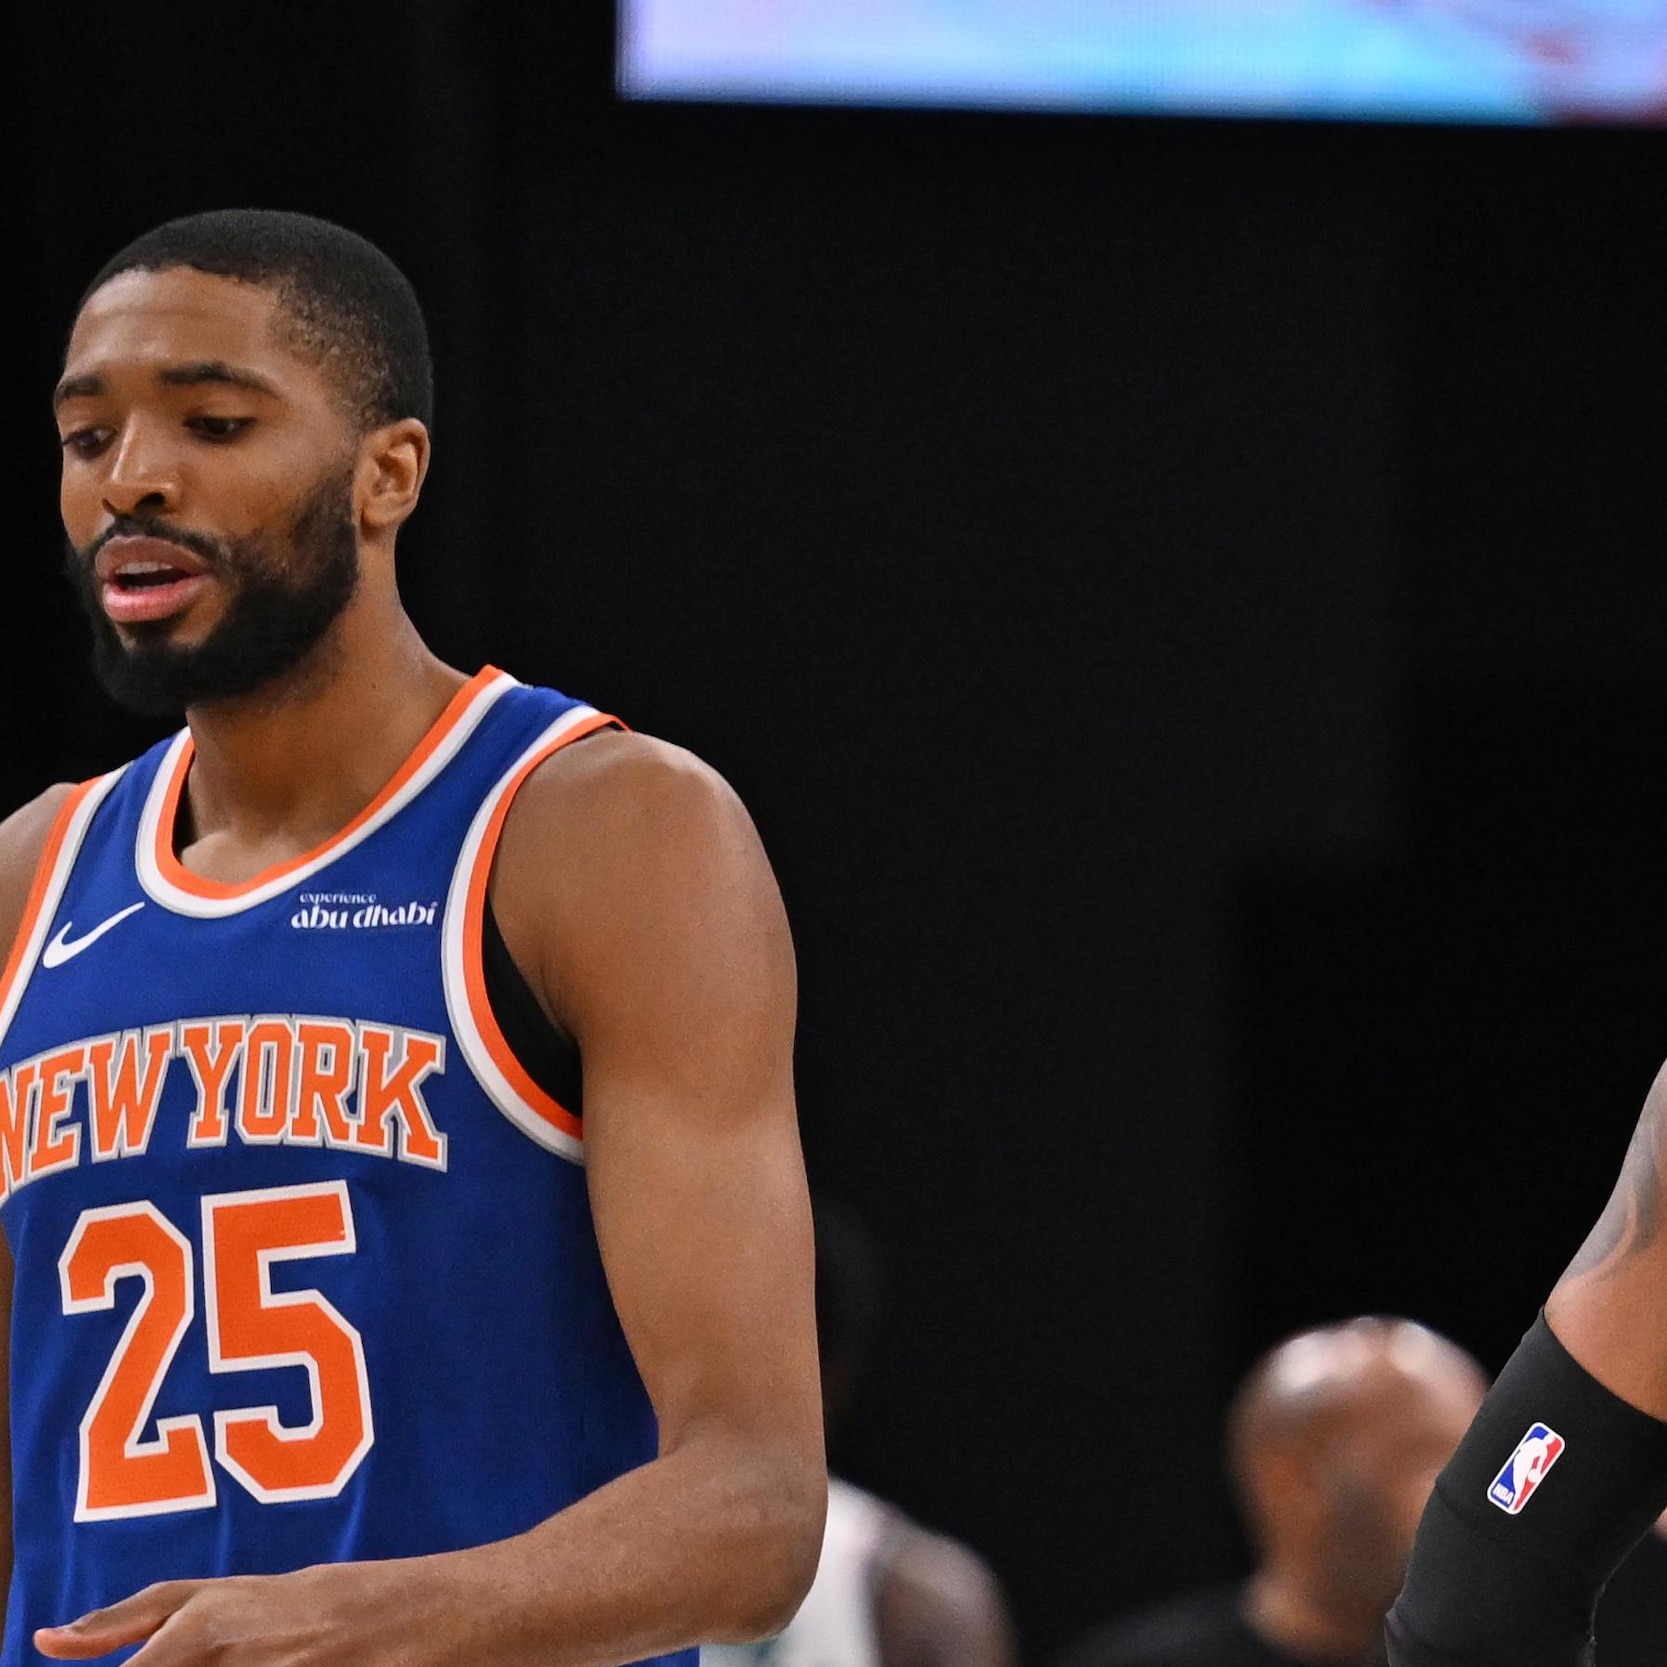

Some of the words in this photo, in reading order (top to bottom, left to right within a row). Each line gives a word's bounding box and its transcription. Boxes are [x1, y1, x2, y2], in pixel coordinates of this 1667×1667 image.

[291, 905, 348, 929] abu
[353, 901, 438, 929] dhabi
[300, 892, 377, 905] experience
[0, 1021, 176, 1208] NEW
[177, 1013, 447, 1173] YORK
[59, 1180, 374, 1523] 25
